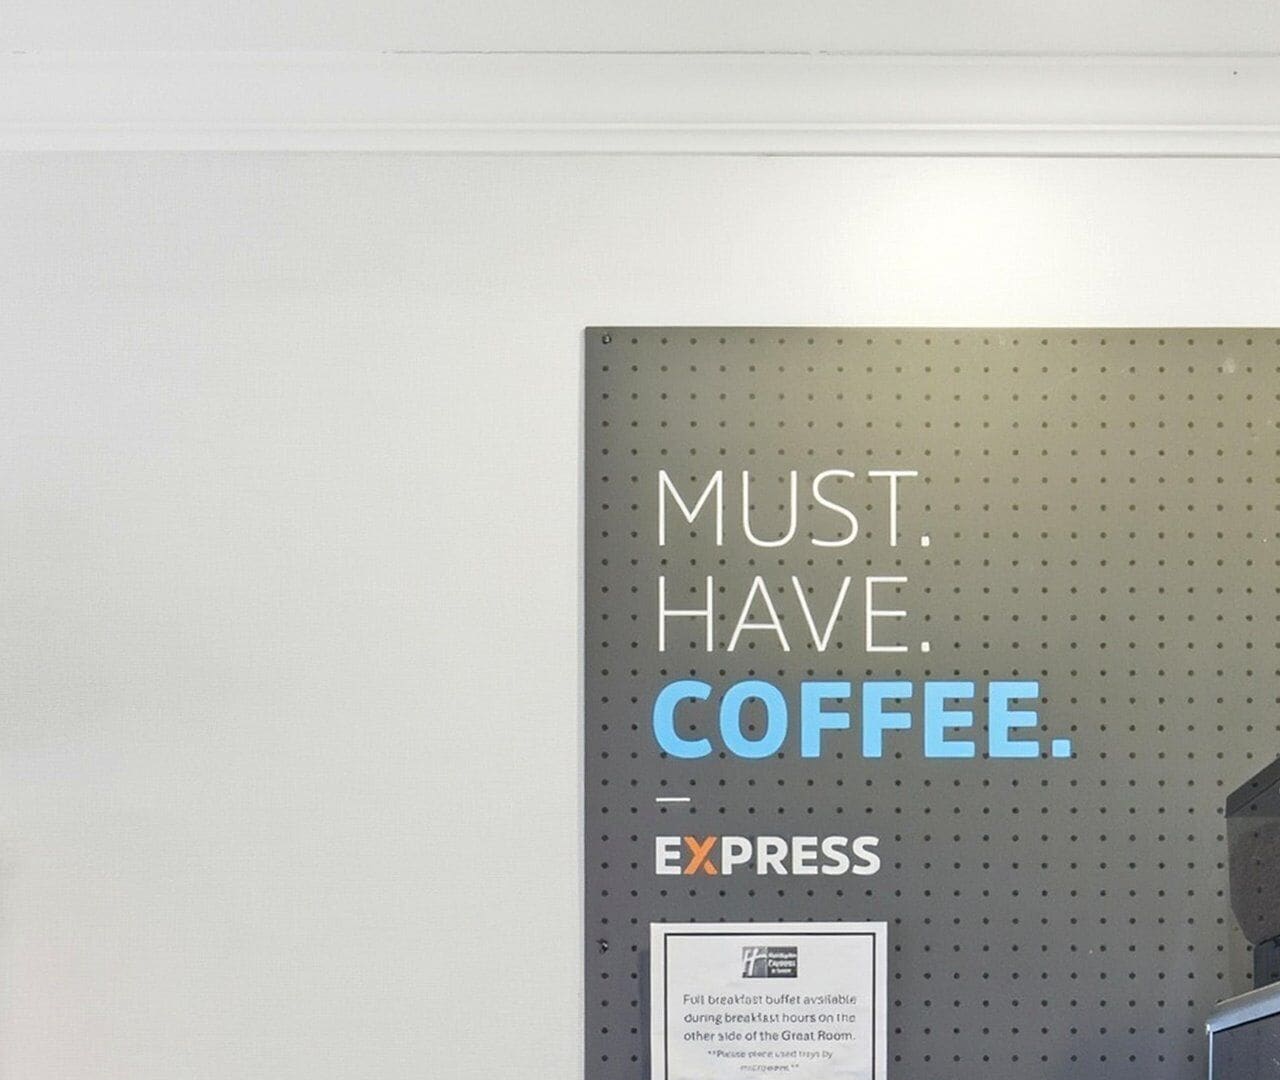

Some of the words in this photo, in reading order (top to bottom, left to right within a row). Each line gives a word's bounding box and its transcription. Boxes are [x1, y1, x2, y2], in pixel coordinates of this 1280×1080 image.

[658, 469, 930, 547] MUST.
[658, 575, 930, 652] HAVE.
[651, 679, 1071, 760] COFFEE.
[655, 835, 880, 876] EXPRESS
[683, 994, 705, 1005] Full
[708, 994, 763, 1005] breakfast
[765, 994, 800, 1005] buffet
[804, 994, 856, 1005] available
[684, 1013, 722, 1025] during
[725, 1013, 779, 1023] breakfast
[782, 1013, 816, 1023] hours
[818, 1014, 834, 1023] on
[837, 1013, 856, 1023] the
[684, 1031, 715, 1041] other
[718, 1031, 742, 1041] side
[745, 1031, 758, 1041] of
[760, 1031, 779, 1041] the
[782, 1031, 813, 1041] Great
[818, 1031, 856, 1041] Room.
